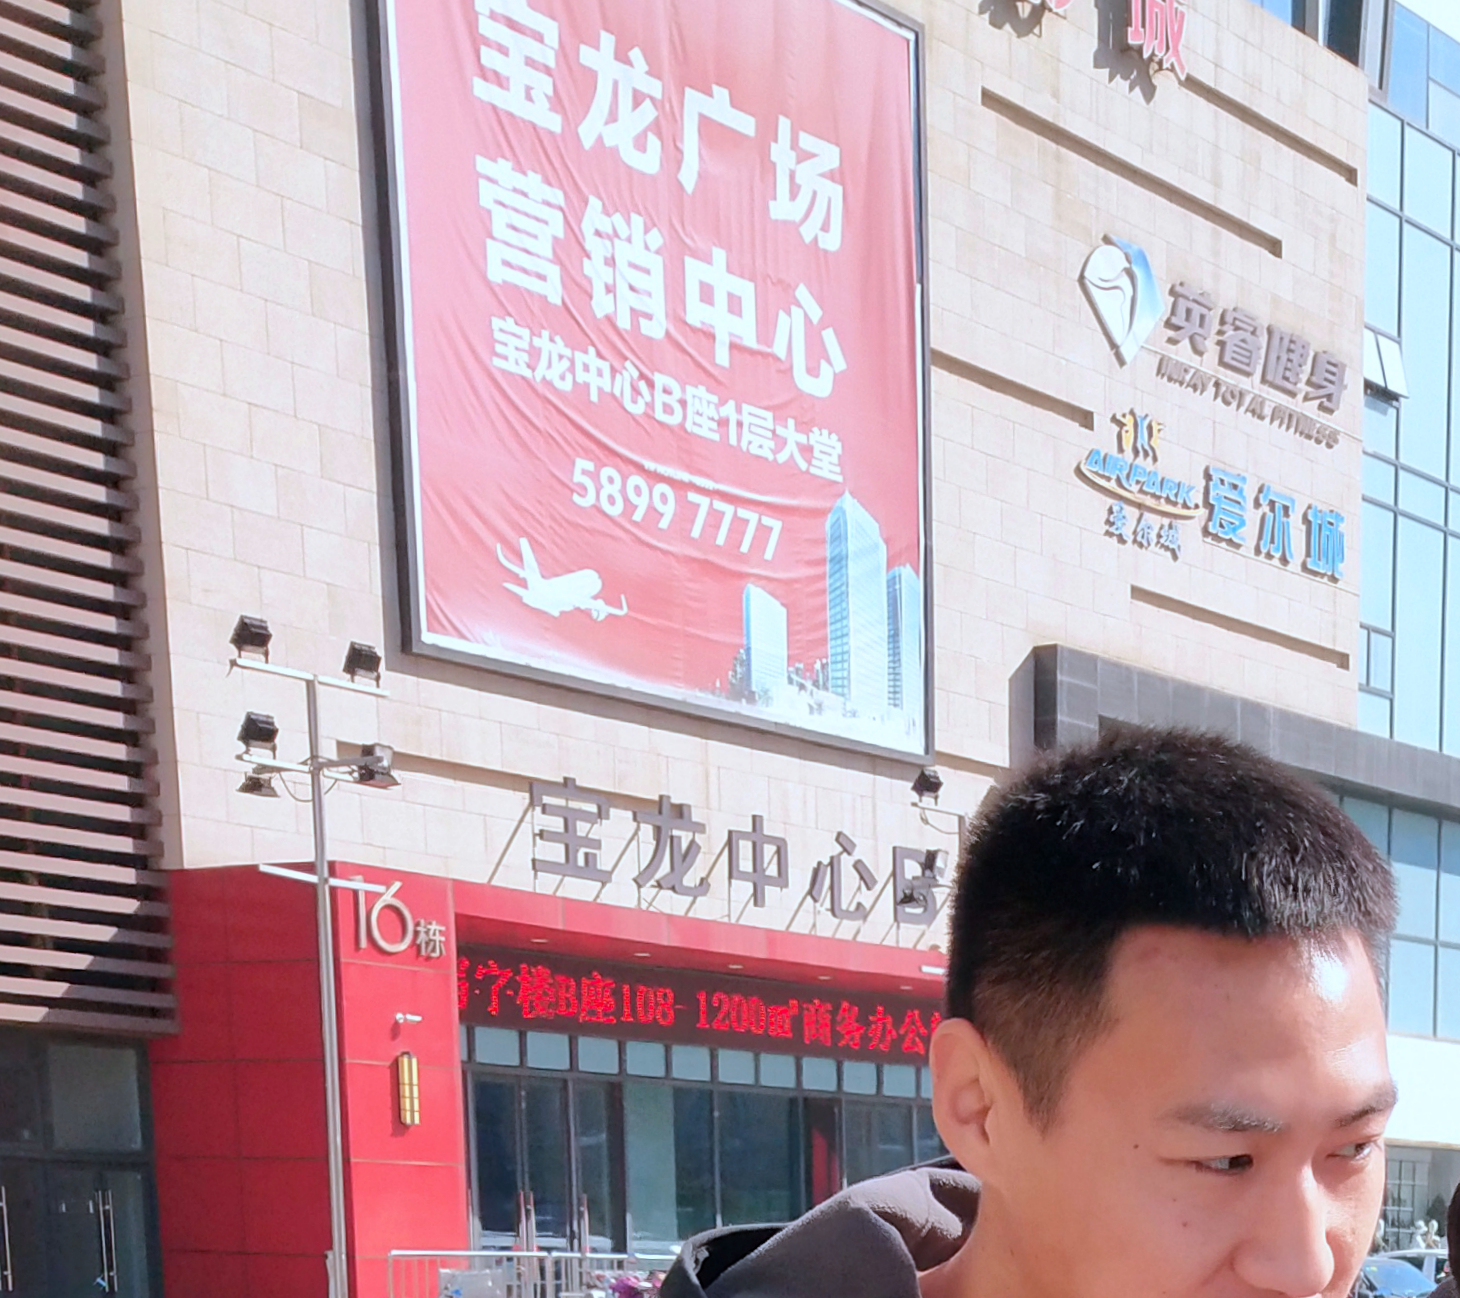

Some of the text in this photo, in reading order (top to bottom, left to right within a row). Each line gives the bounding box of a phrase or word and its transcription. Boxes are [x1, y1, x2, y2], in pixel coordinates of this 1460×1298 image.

[472, 0, 844, 252] 宝龙广场
[474, 154, 848, 399] 营销中心
[490, 315, 844, 483] 宝龙中心B座1层大堂
[1164, 281, 1348, 416] 英睿健身
[1213, 378, 1267, 422] TOTAL
[572, 457, 676, 530] 5899
[686, 491, 783, 561] 7777
[1084, 448, 1199, 509] AIRPARK
[1204, 464, 1345, 584] 爱尔城
[348, 875, 446, 959] 16栋
